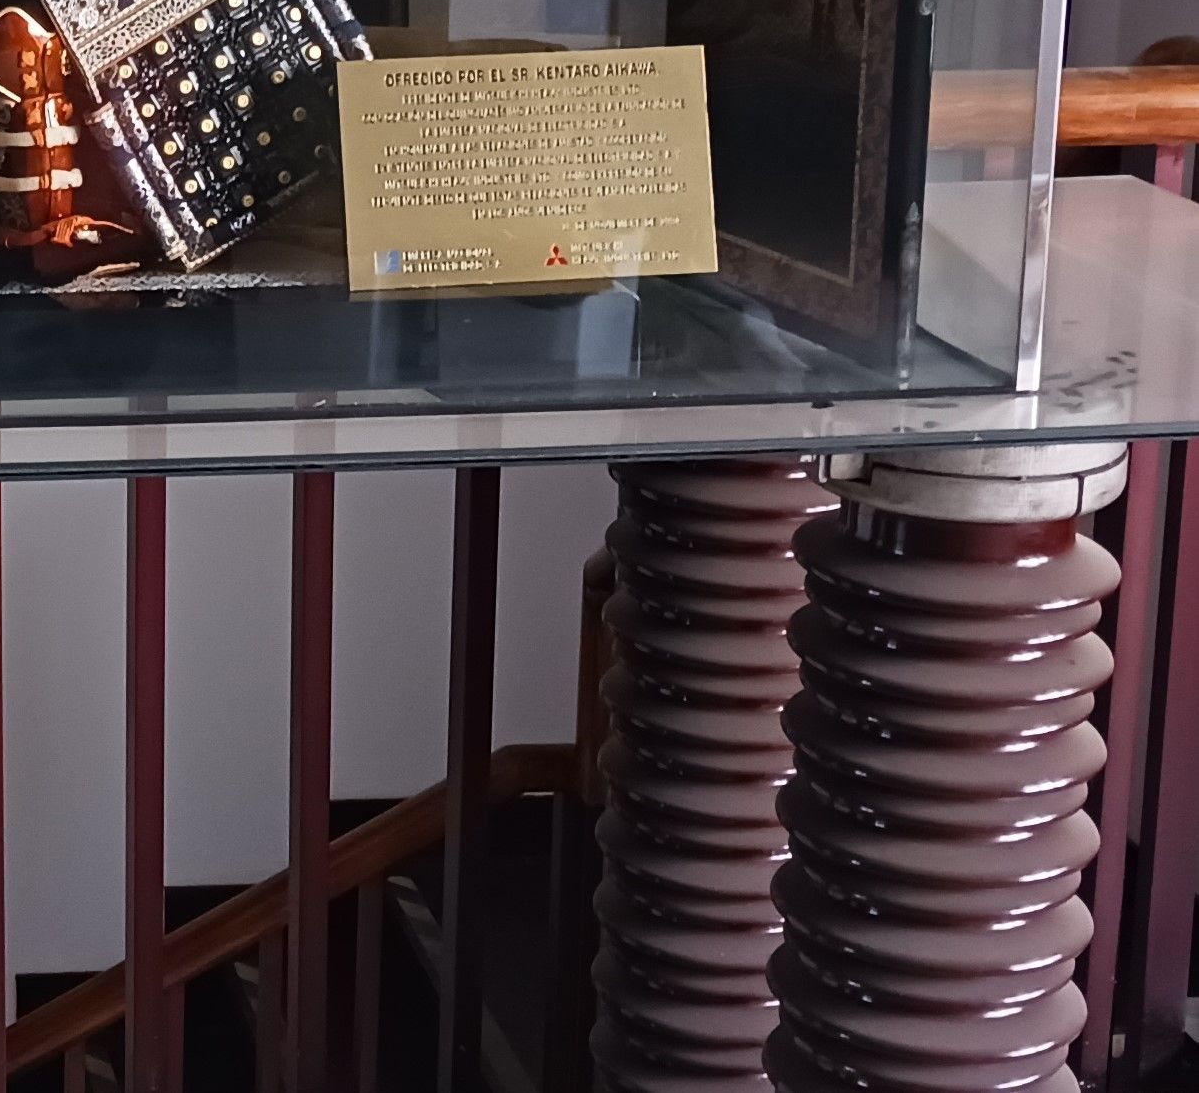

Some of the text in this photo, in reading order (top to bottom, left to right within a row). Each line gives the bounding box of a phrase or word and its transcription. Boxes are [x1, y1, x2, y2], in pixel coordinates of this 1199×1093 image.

[385, 70, 452, 87] OFRECIDO
[457, 69, 484, 84] POR
[490, 68, 505, 82] EL
[536, 63, 600, 80] KENTARO
